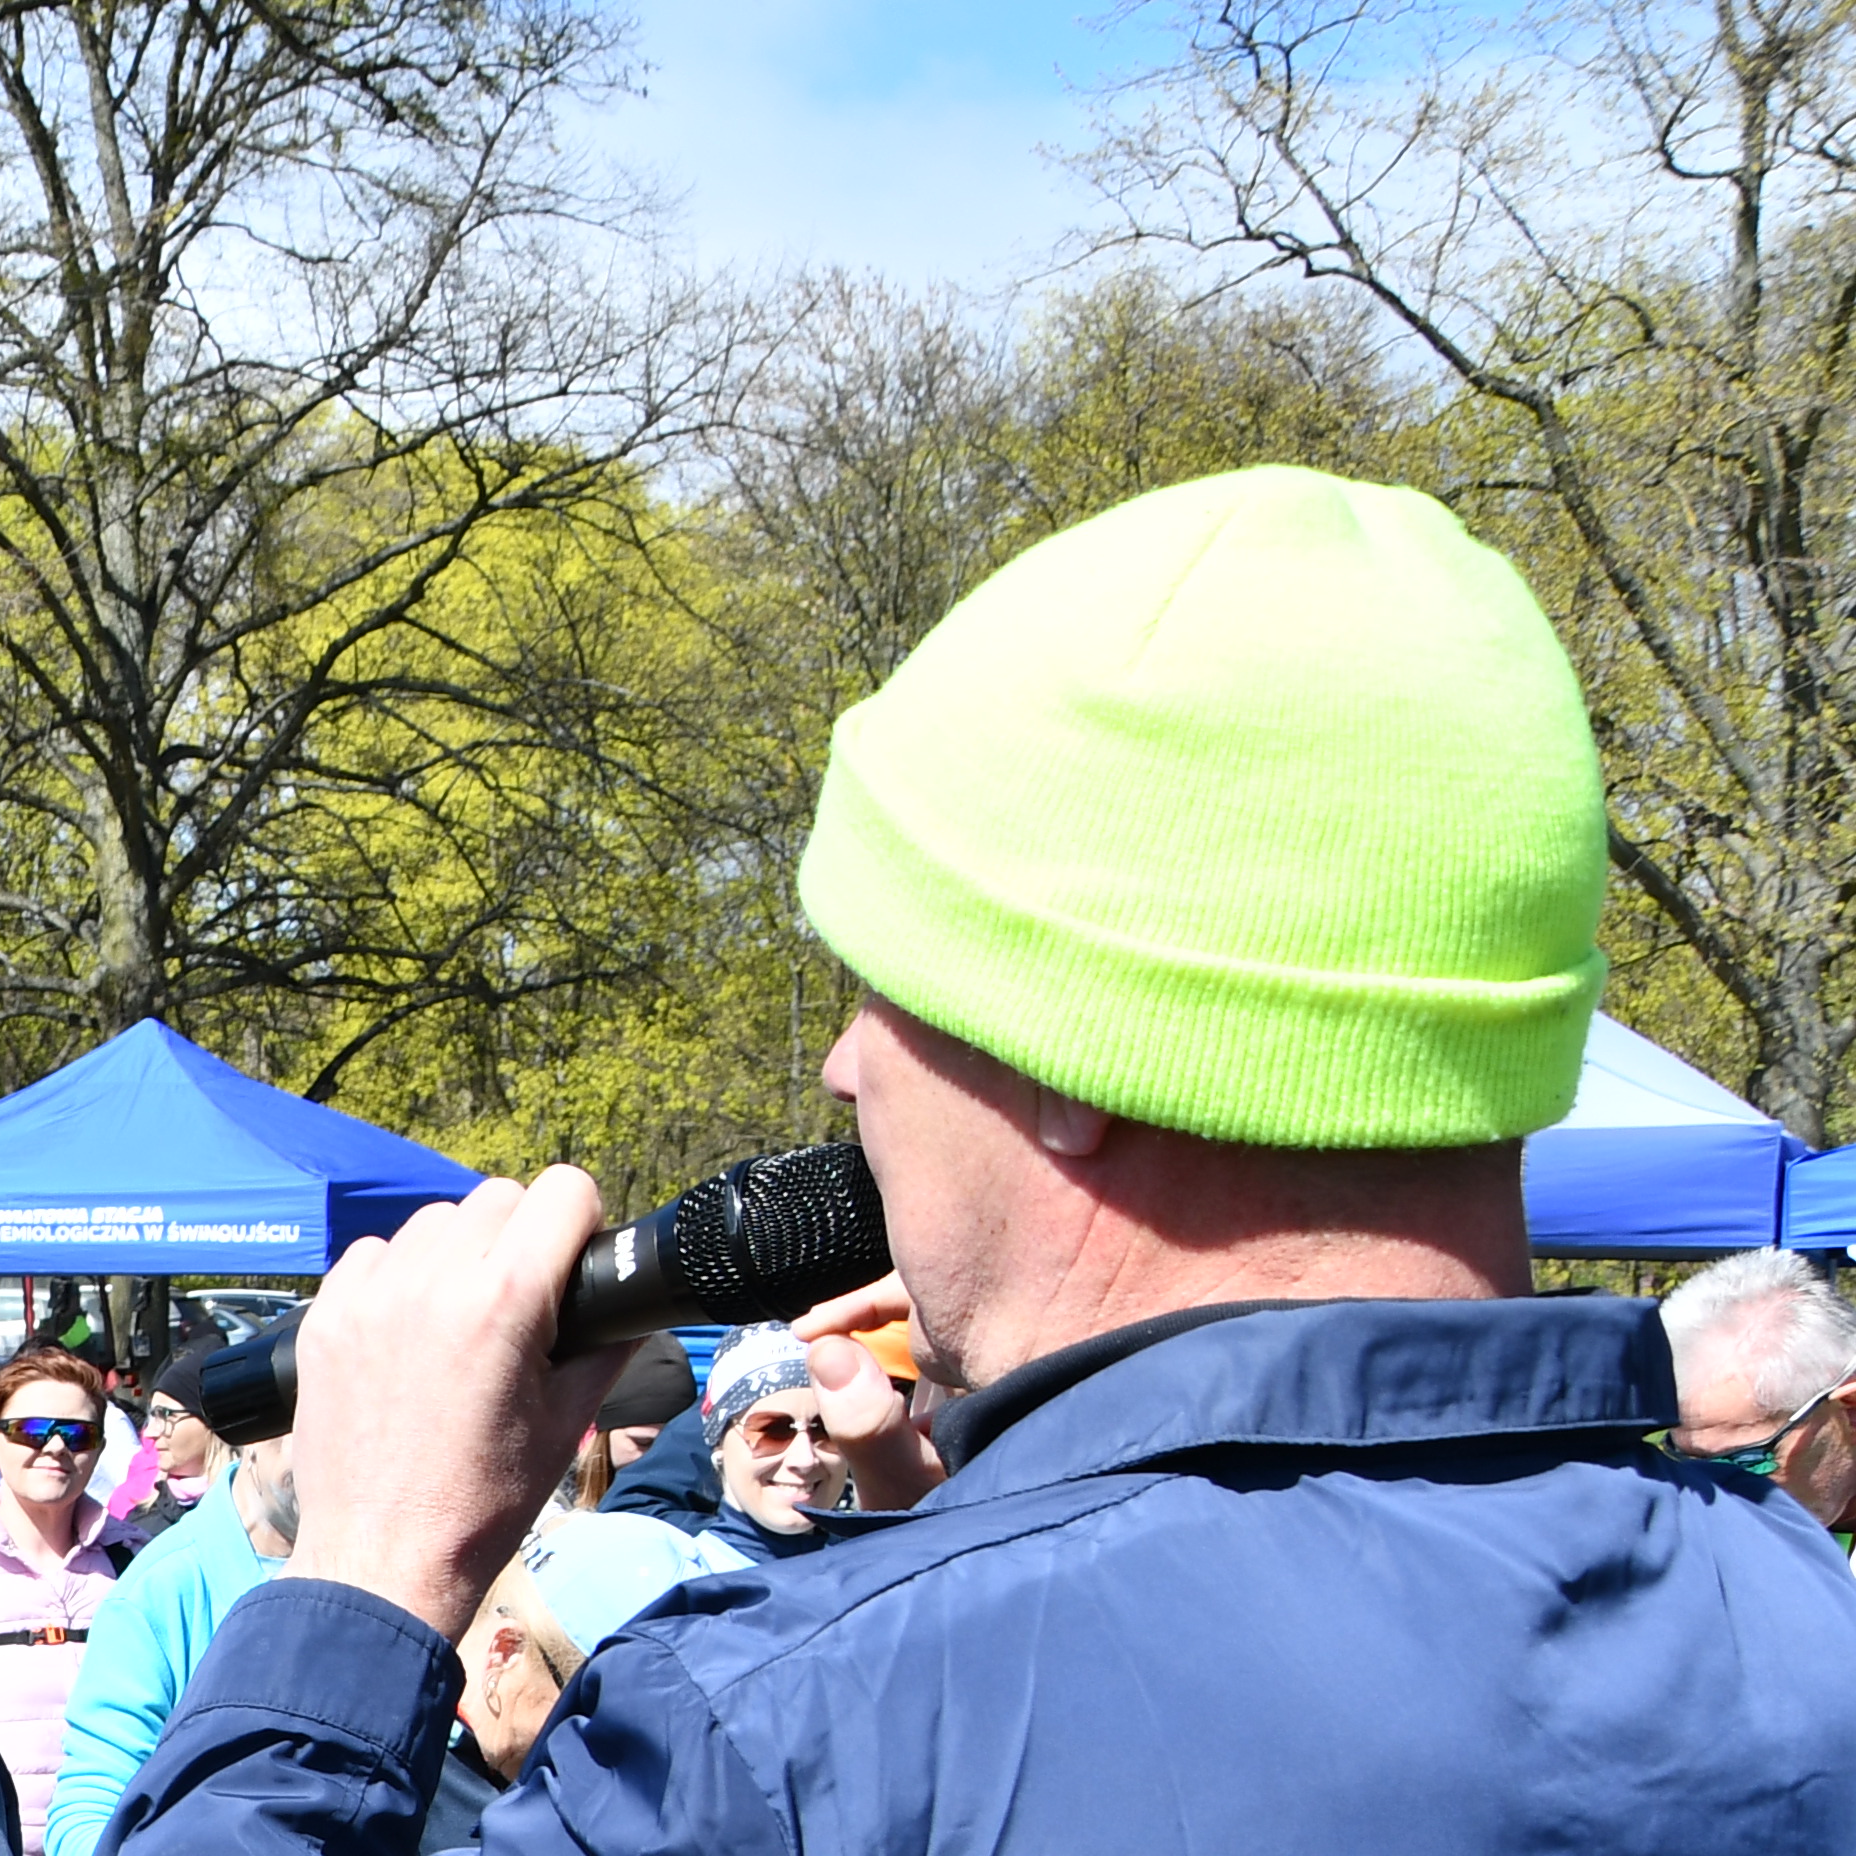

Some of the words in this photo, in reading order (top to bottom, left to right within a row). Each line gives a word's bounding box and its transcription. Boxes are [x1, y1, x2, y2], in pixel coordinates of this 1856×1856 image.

[91, 1206, 164, 1223] STACJA
[143, 1225, 164, 1242] W
[167, 1220, 300, 1243] ŚWINOUJŚCIU
[614, 1226, 637, 1282] DNA
